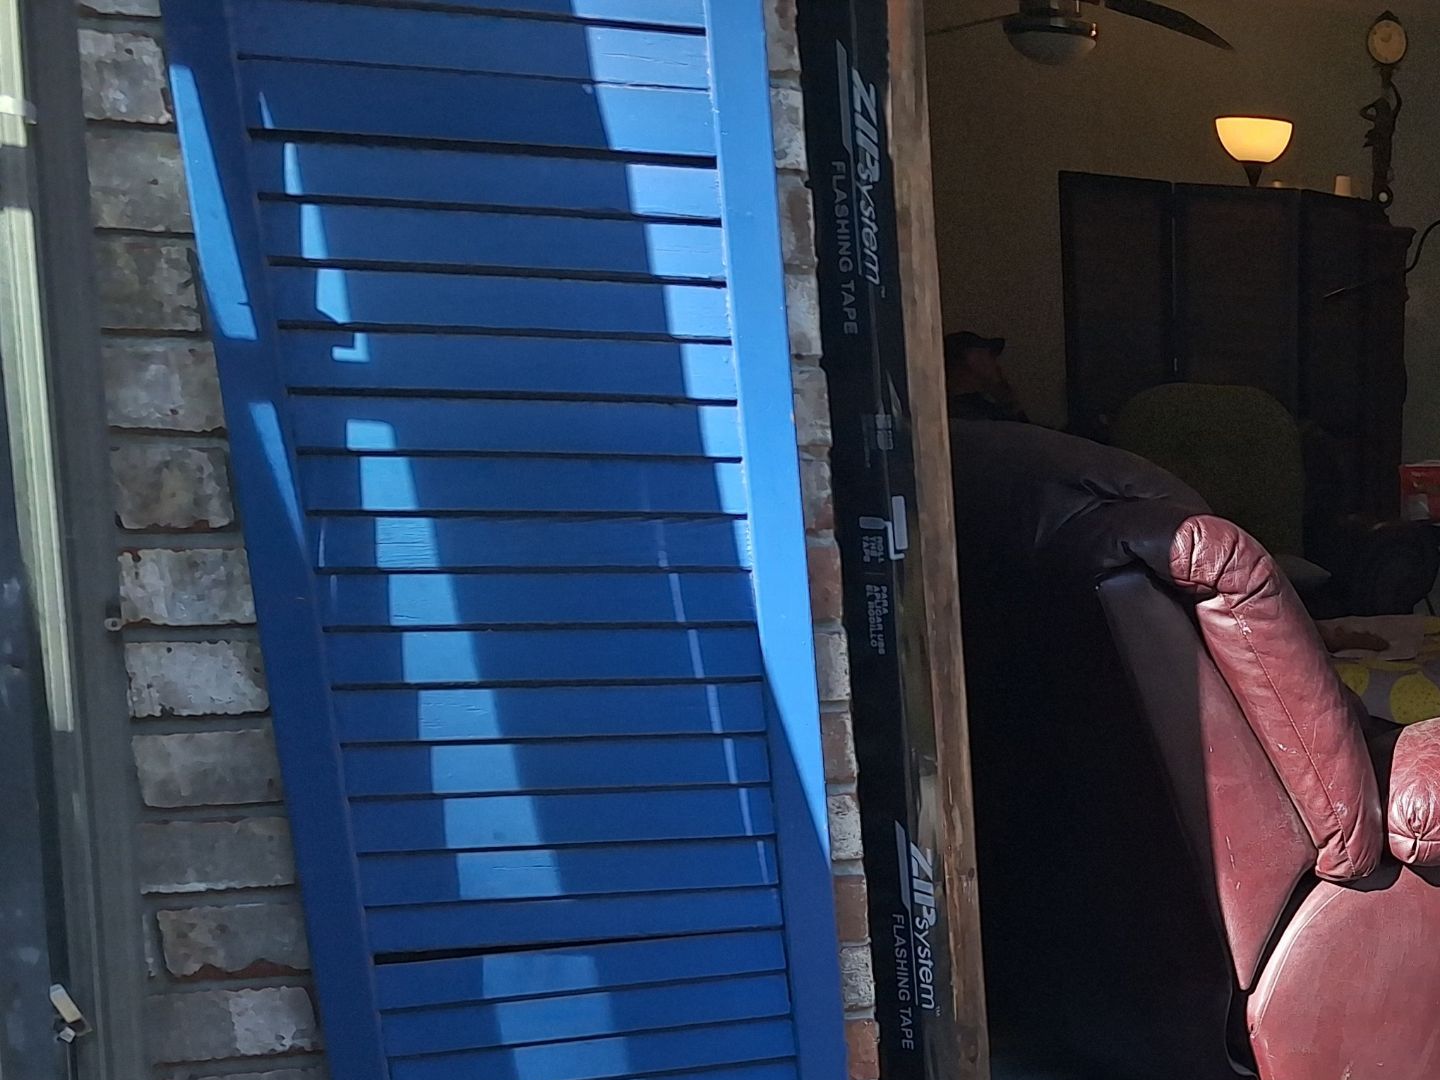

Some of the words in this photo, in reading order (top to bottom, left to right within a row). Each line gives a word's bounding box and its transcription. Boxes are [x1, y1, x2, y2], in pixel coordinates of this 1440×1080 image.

[831, 160, 854, 273] FLASHING
[840, 277, 858, 336] TAPE
[892, 913, 909, 1000] FLASHING
[900, 1006, 914, 1050] TAPE
